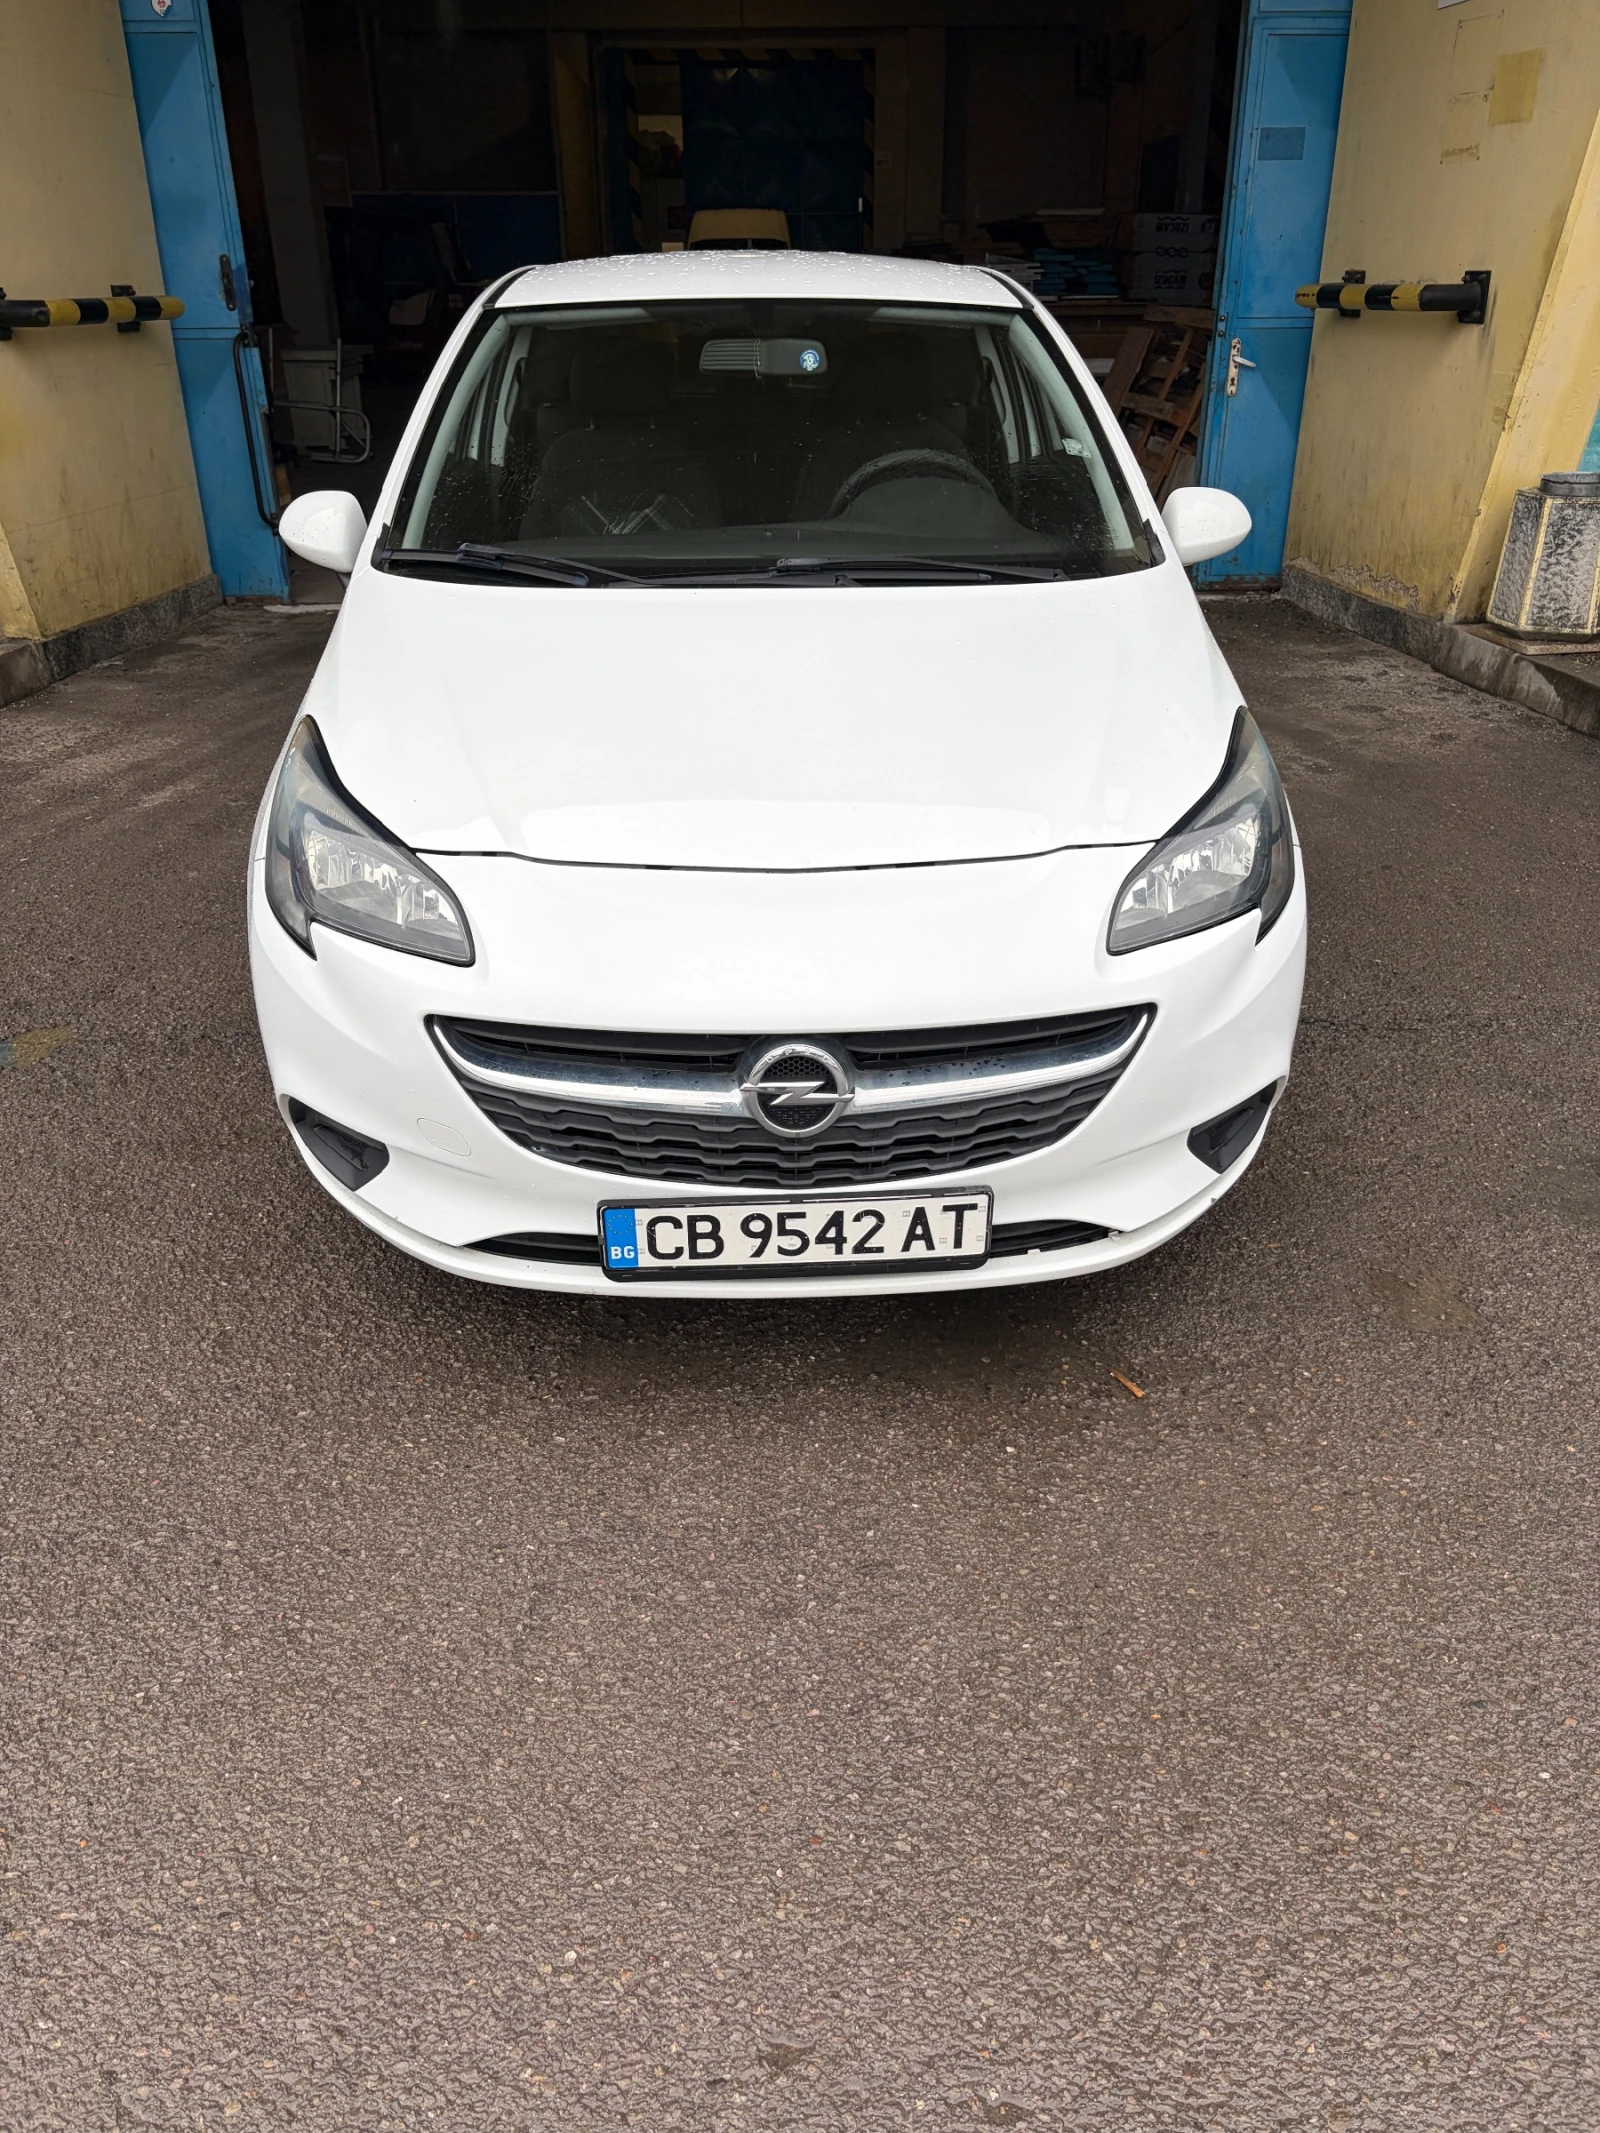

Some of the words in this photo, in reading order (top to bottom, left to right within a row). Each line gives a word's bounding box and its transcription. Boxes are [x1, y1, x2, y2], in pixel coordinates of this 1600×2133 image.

[1155, 222, 1189, 233] IZOCAM
[1154, 274, 1188, 285] IZOCAM
[646, 1214, 724, 1260] CB
[740, 1209, 885, 1258] 9542
[901, 1203, 978, 1252] AT
[611, 1246, 635, 1260] BG
